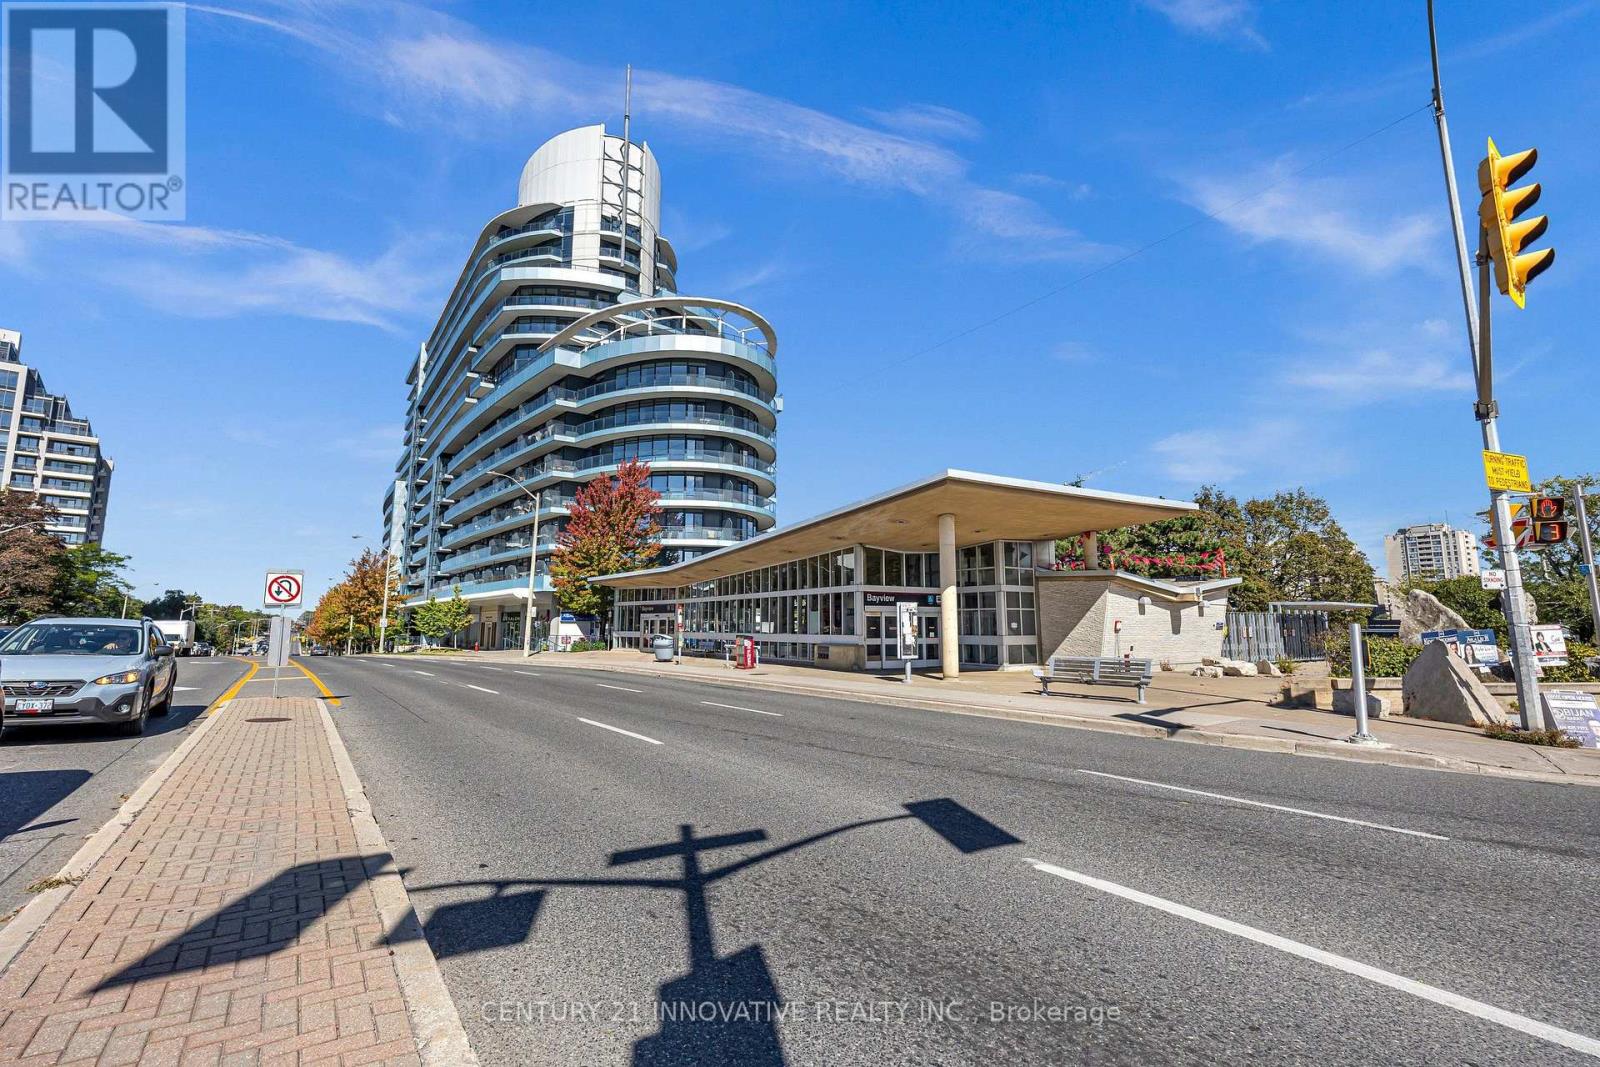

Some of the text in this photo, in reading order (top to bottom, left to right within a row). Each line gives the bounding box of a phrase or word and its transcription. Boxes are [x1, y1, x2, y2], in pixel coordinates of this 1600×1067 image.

[1485, 453, 1527, 469] TURNING TRAFFIC
[1491, 467, 1520, 478] MUST YIELD
[1496, 478, 1529, 490] PEDESTRIANS
[867, 593, 896, 603] Bayview
